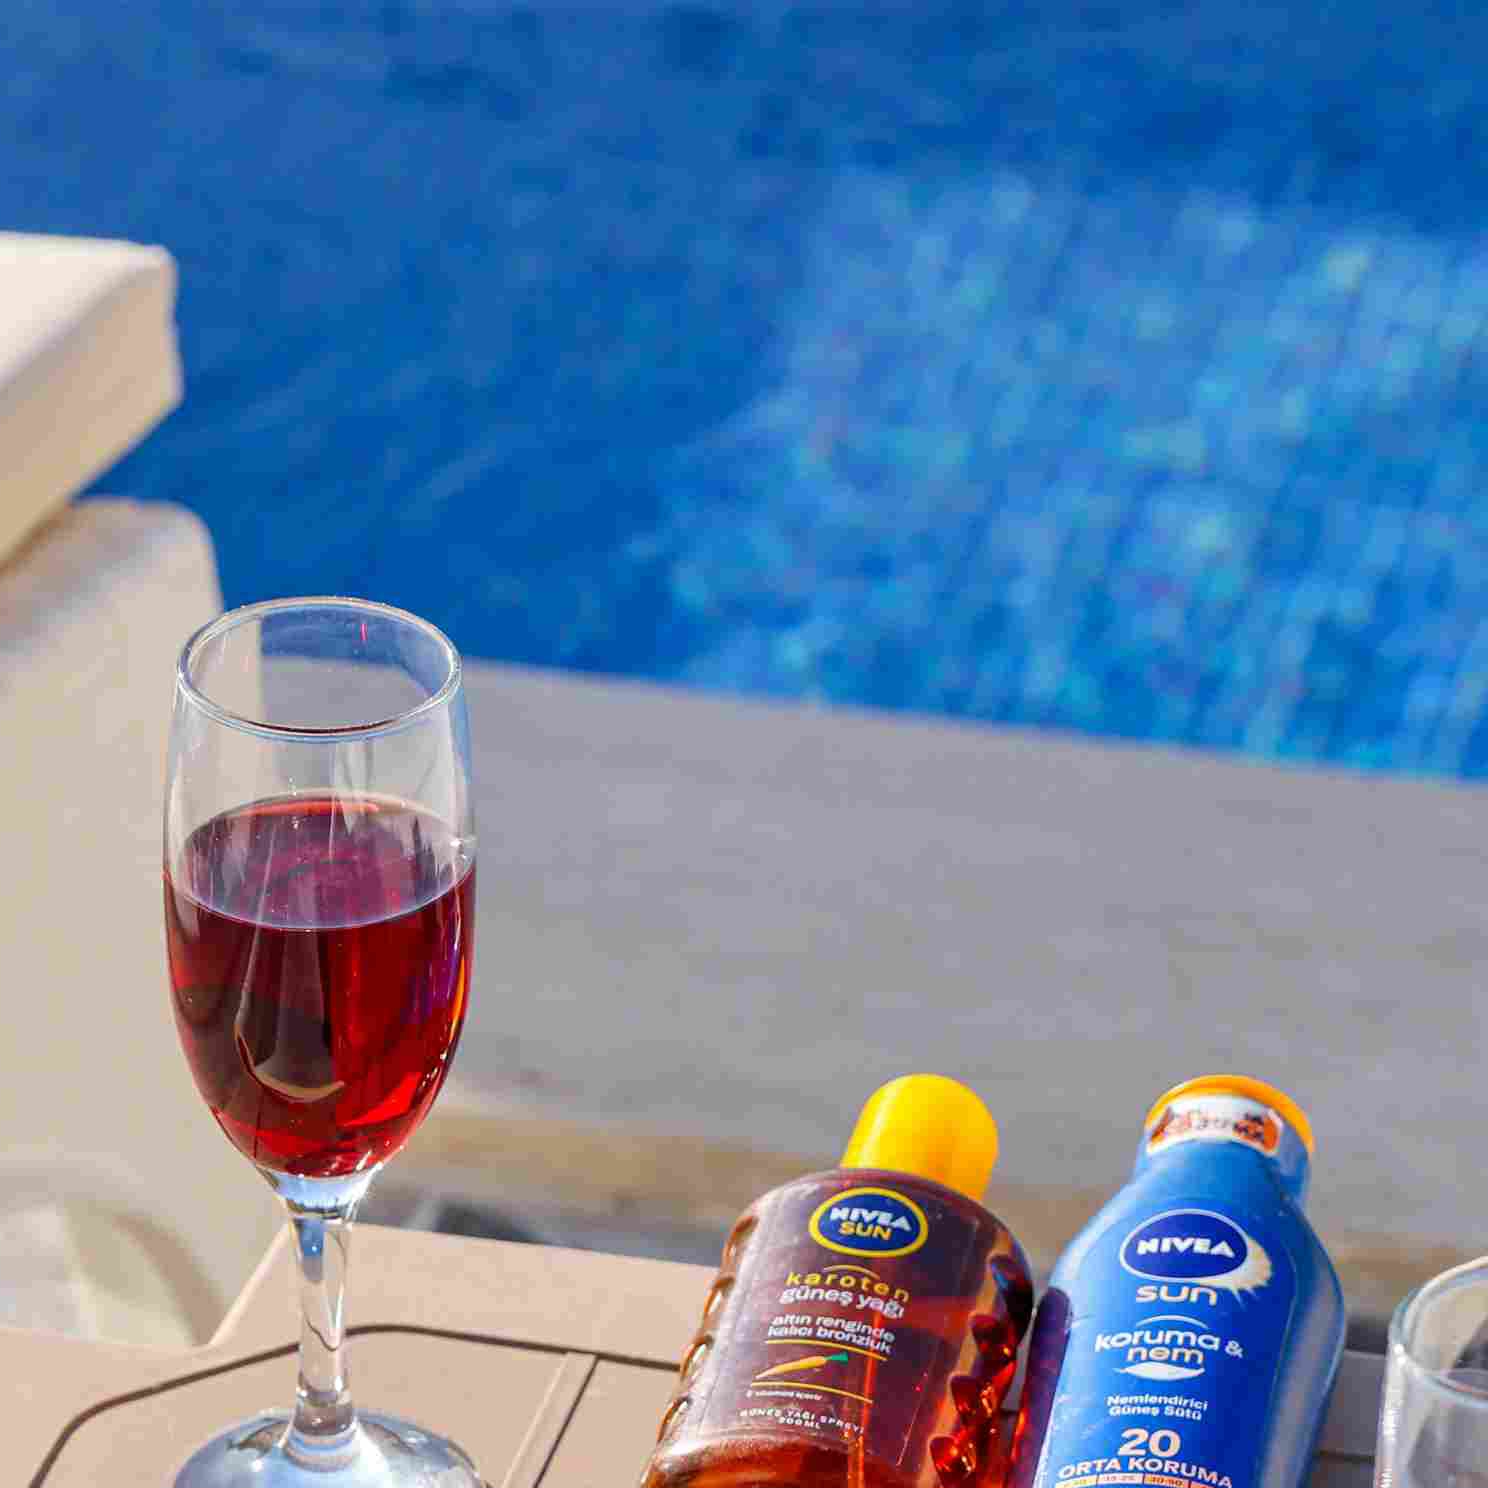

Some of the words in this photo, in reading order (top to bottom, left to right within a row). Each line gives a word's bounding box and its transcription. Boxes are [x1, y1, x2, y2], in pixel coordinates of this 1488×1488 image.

[829, 1207, 912, 1232] NIVEA
[838, 1221, 892, 1241] SUN
[1137, 1236, 1235, 1259] NIVEA
[785, 1271, 910, 1302] karoten
[1136, 1284, 1217, 1306] sun
[815, 1315, 896, 1343] renginde
[816, 1326, 892, 1354] bronzluk
[1094, 1329, 1220, 1352] koruma
[1225, 1340, 1244, 1358] &
[1126, 1346, 1205, 1365] nem
[1106, 1393, 1209, 1412] Nemlendirici
[1117, 1427, 1181, 1458] 20
[1058, 1457, 1121, 1480] ORTA
